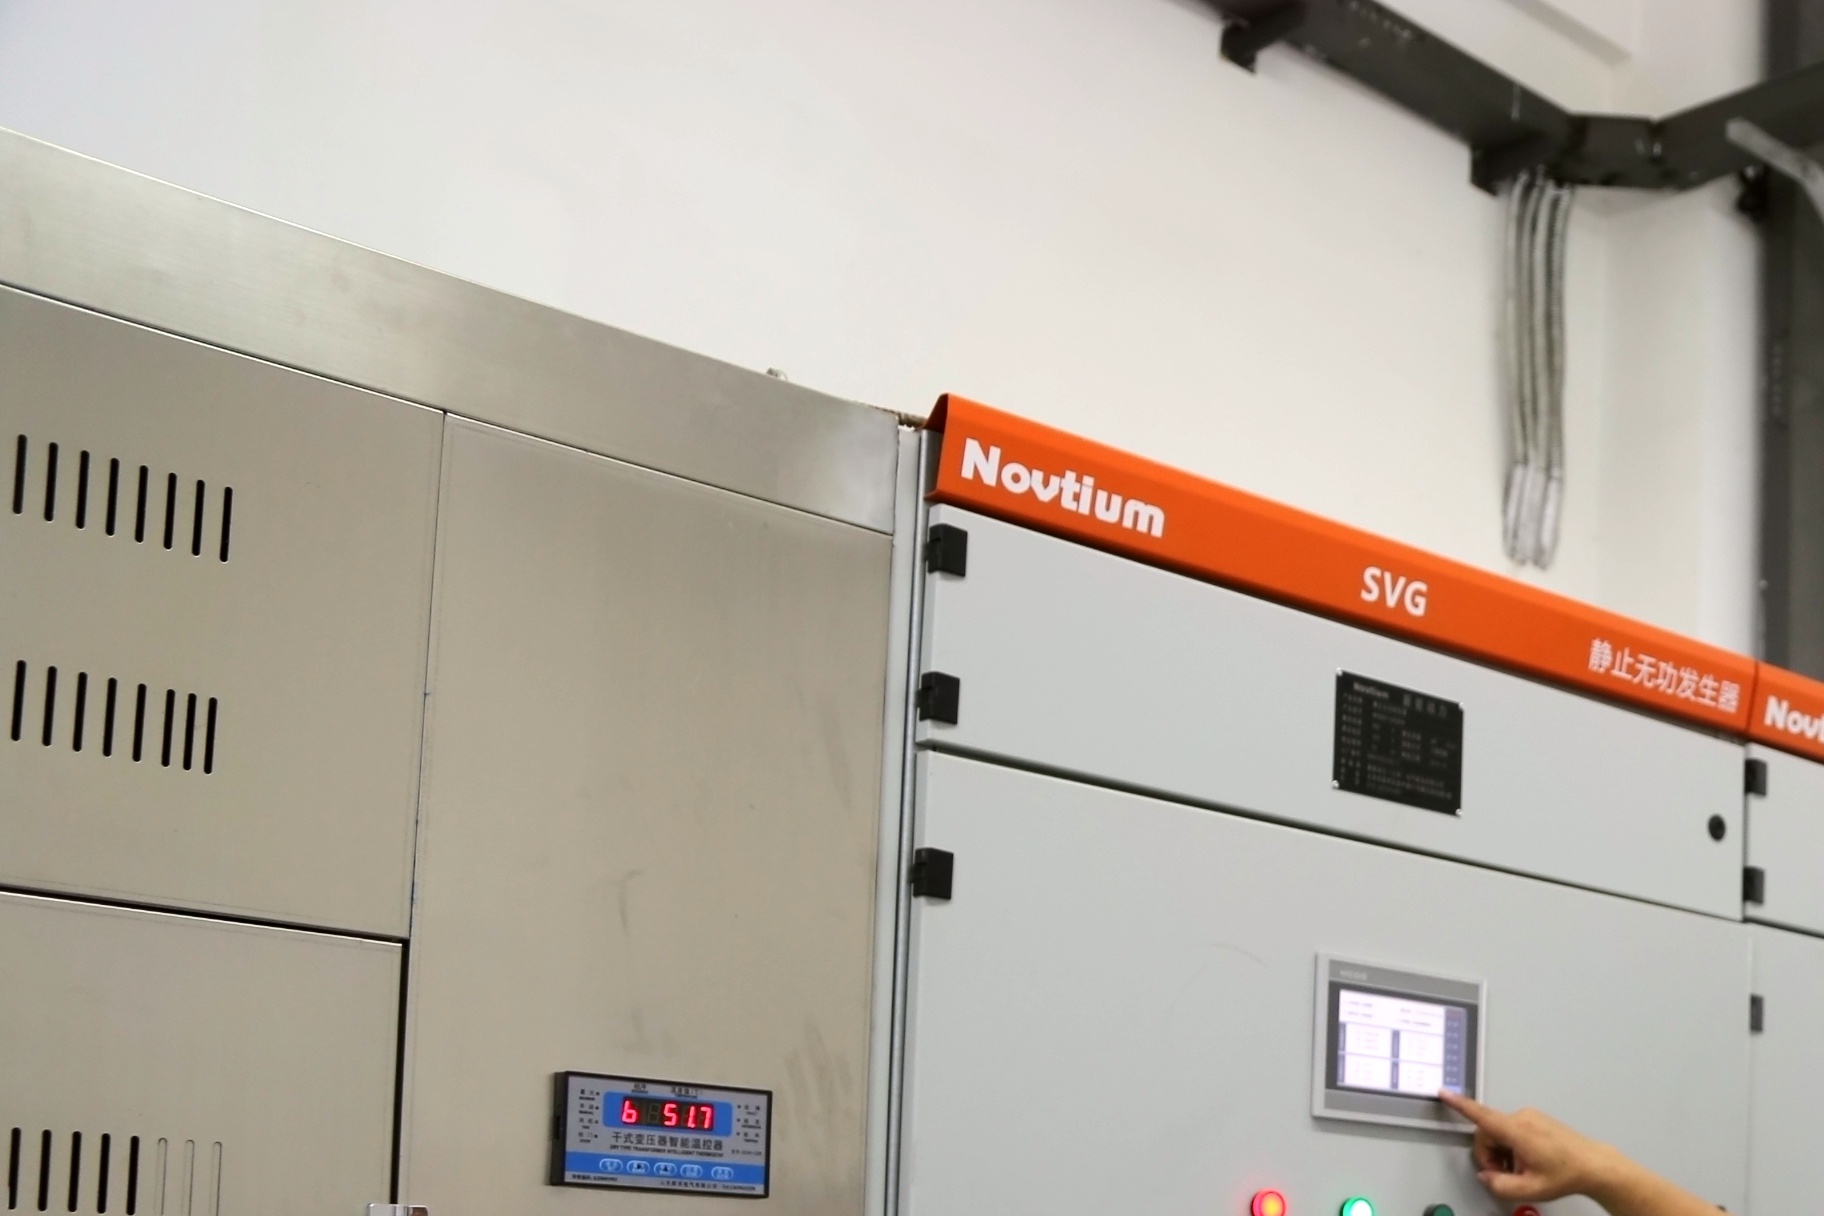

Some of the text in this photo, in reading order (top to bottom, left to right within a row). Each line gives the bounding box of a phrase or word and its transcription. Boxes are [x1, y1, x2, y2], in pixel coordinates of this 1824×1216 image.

[961, 438, 1165, 538] Novtium
[1360, 566, 1428, 617] SVG
[1588, 639, 1740, 714] 静止无功发生器
